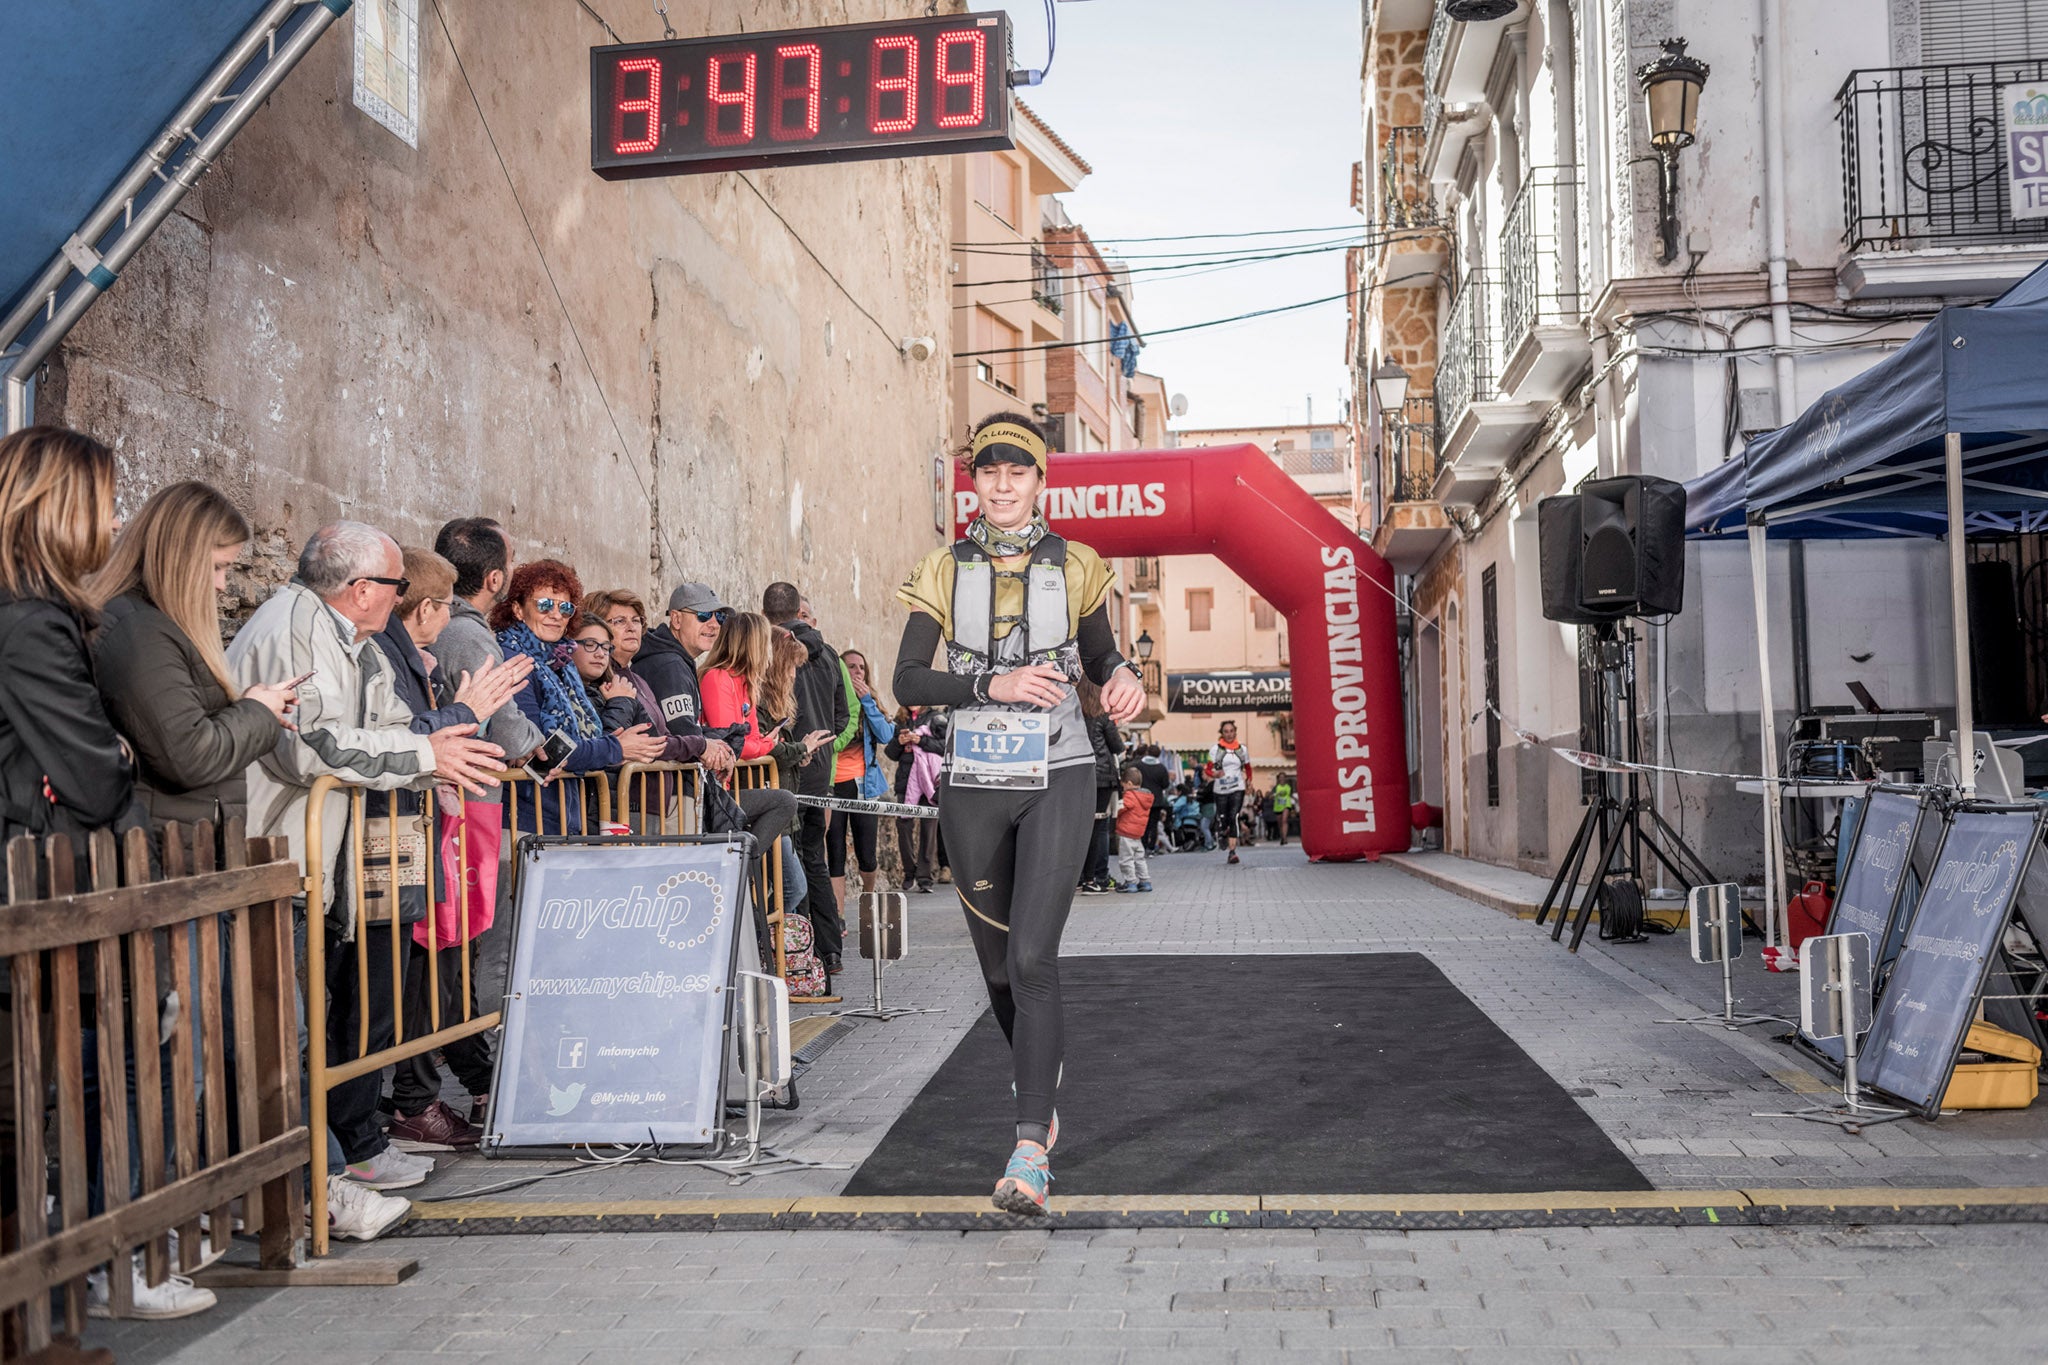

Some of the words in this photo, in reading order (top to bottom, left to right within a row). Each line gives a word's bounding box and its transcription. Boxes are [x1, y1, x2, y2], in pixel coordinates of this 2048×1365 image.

[990, 430, 1032, 446] LURBEL
[1321, 546, 1370, 761] PROVINCIAS
[1183, 695, 1217, 706] bebida
[1220, 697, 1242, 707] para
[970, 734, 1025, 754] 1117
[1338, 765, 1376, 834] LAS
[538, 886, 691, 939] mychip
[528, 971, 711, 999] www.mychip.es
[597, 1045, 660, 1058] /infomychip
[591, 1091, 666, 1105] @Mychip_Info
